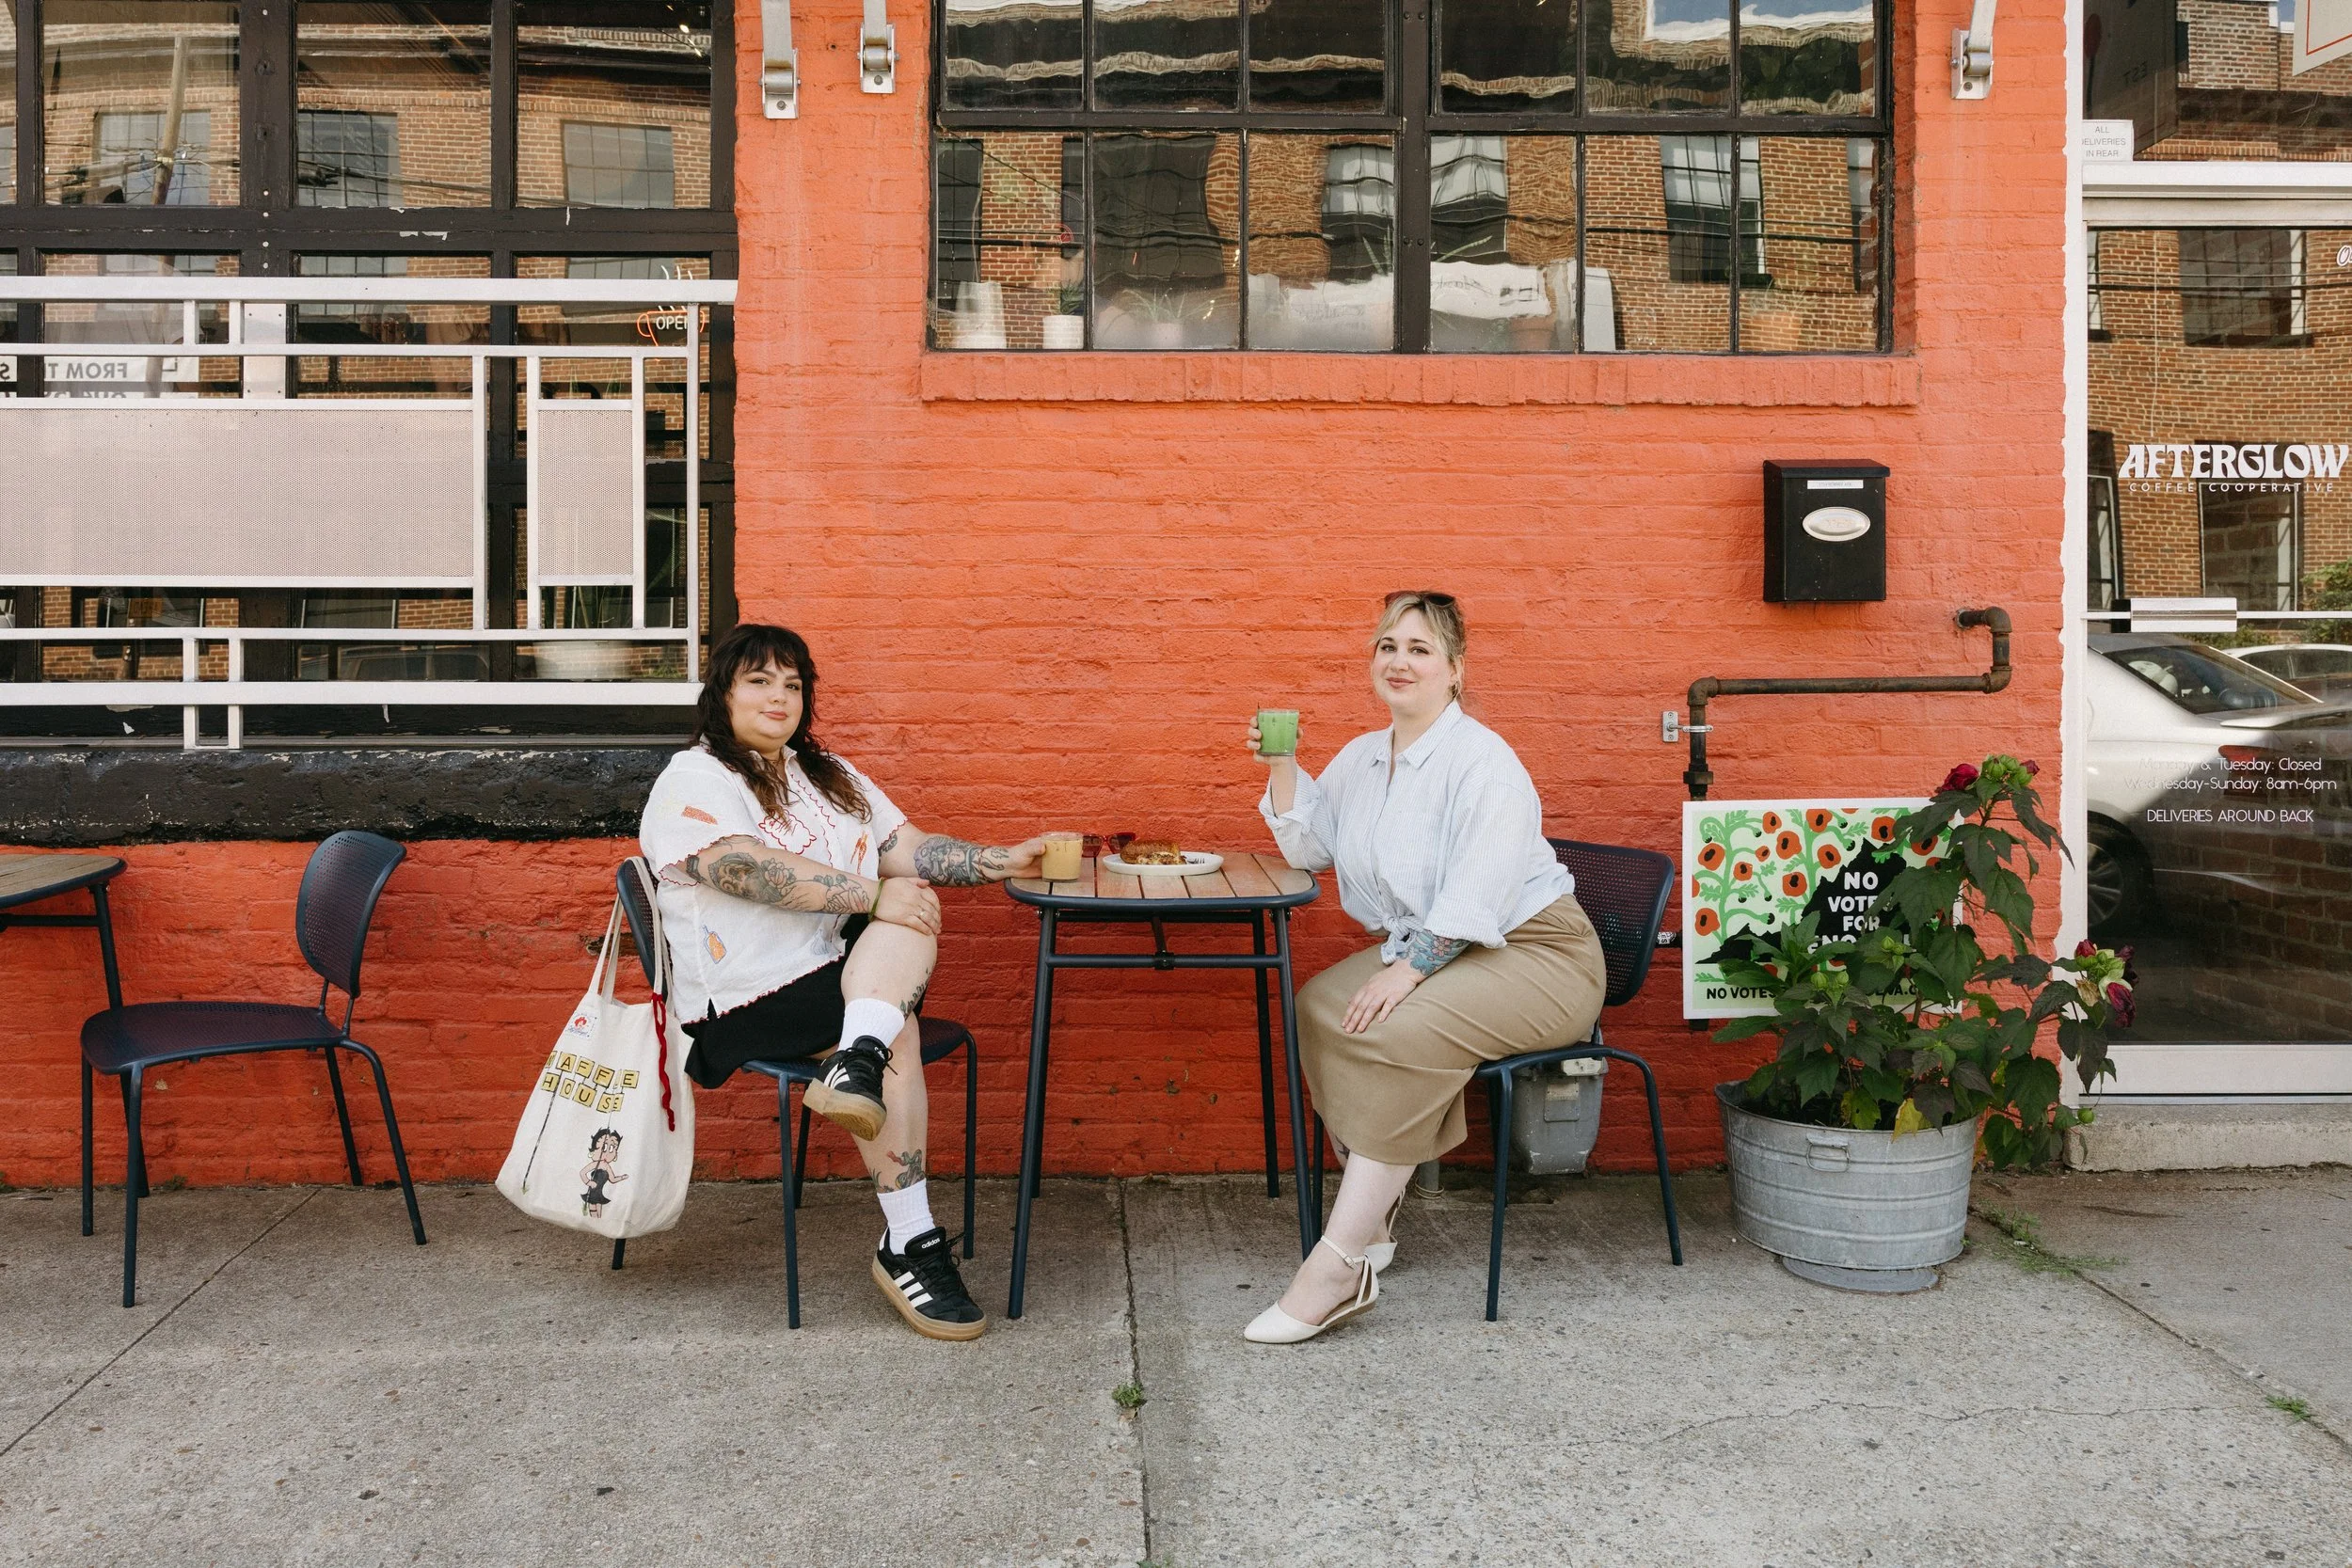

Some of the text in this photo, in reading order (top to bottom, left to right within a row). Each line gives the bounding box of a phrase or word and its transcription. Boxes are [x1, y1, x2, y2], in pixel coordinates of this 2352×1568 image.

[656, 315, 687, 329] OPE
[2118, 444, 2349, 478] AFTERGLOW
[2129, 483, 2333, 492] COFFEE COOPERATIVE
[2201, 759, 2212, 770] &
[2217, 756, 2275, 774] Tuesday:
[2279, 756, 2322, 770] Closed
[2265, 776, 2337, 793] 8am-6pm
[2147, 809, 2314, 822] DELIVERIES AROUND BACK
[1844, 871, 1879, 890] NO
[1827, 895, 1893, 912] VOTE
[1842, 915, 1881, 931] FOR
[542, 1075, 621, 1111] HOUSE
[921, 1237, 941, 1249] adidas
